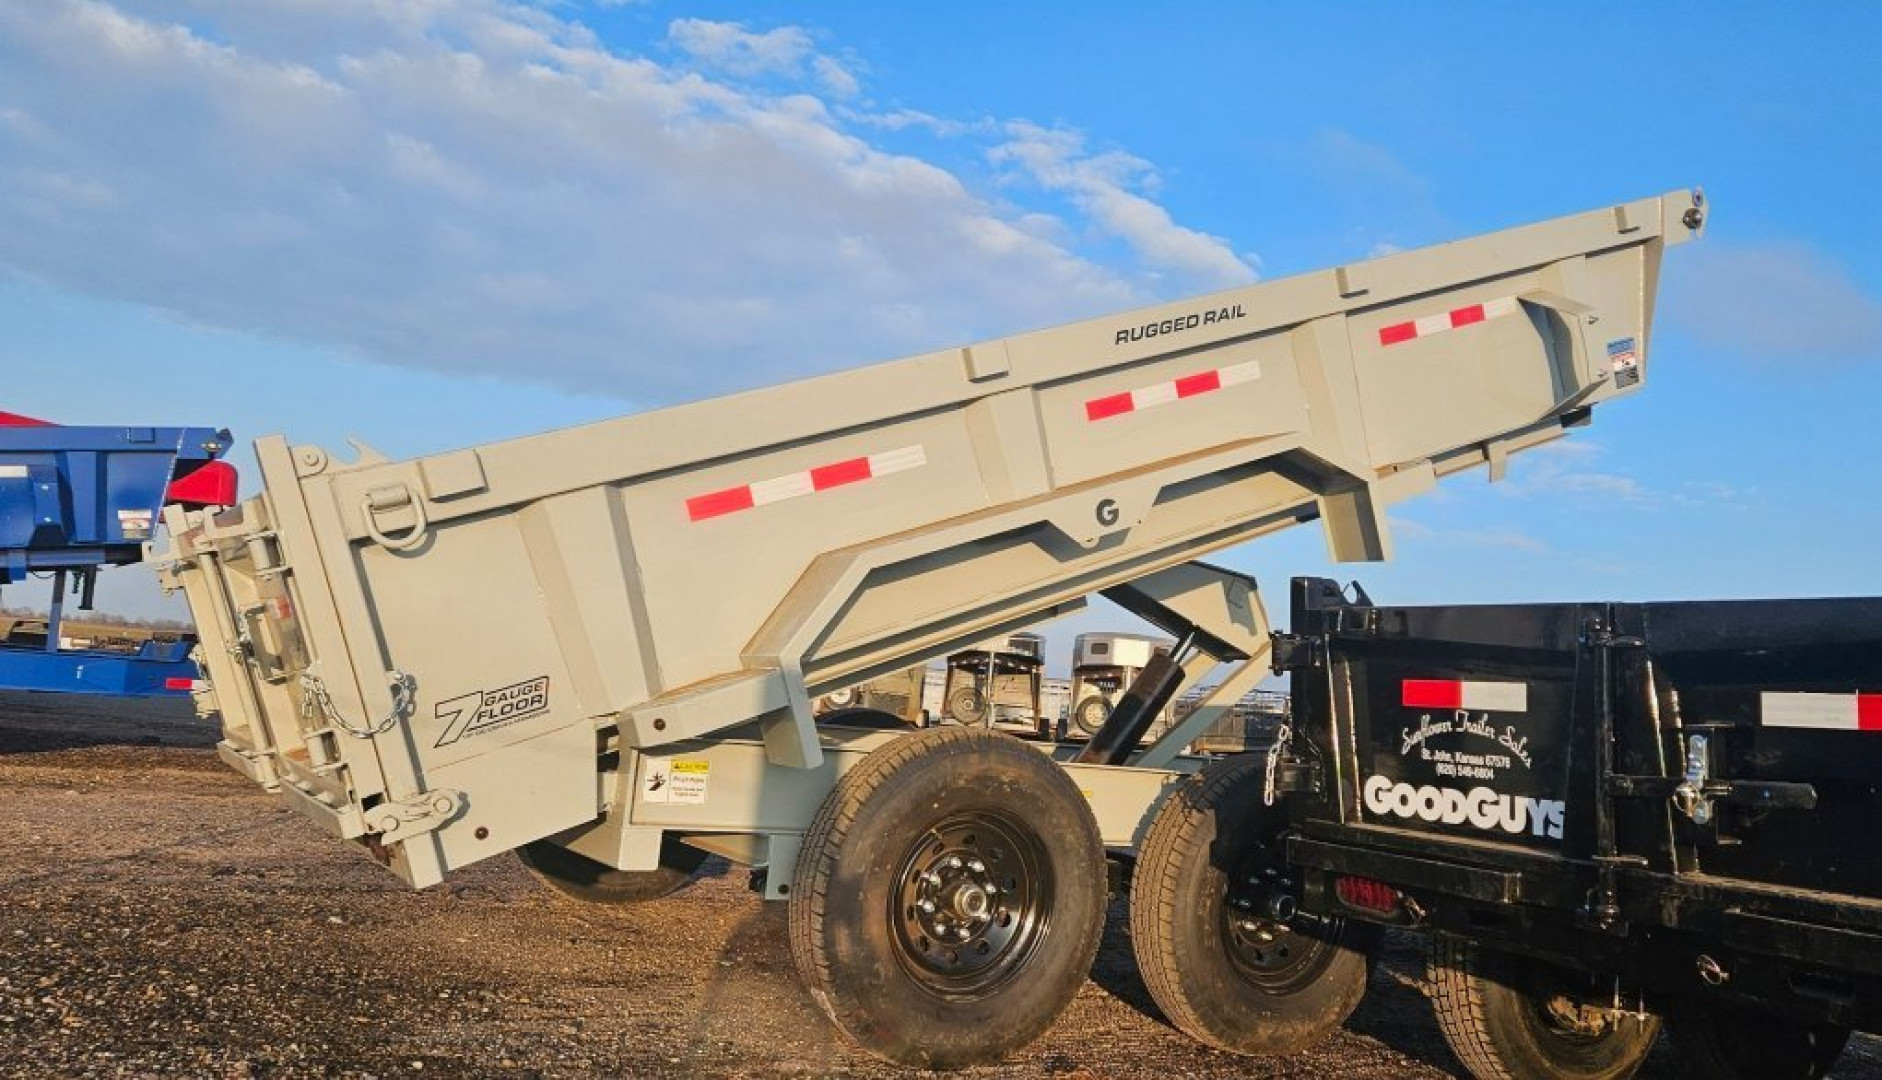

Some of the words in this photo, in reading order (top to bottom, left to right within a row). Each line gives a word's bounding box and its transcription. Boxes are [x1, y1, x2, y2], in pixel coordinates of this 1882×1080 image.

[1115, 314, 1199, 345] RUGGED
[1203, 304, 1247, 325] RAIL
[1096, 498, 1120, 526] G
[433, 690, 484, 749] 7
[484, 681, 544, 707] GAUGE
[476, 694, 543, 723] FLOOR
[1401, 713, 1453, 756] Sunflower
[1455, 709, 1496, 740] Trailer
[1498, 725, 1533, 769] Sales
[1455, 751, 1485, 766] Kansas
